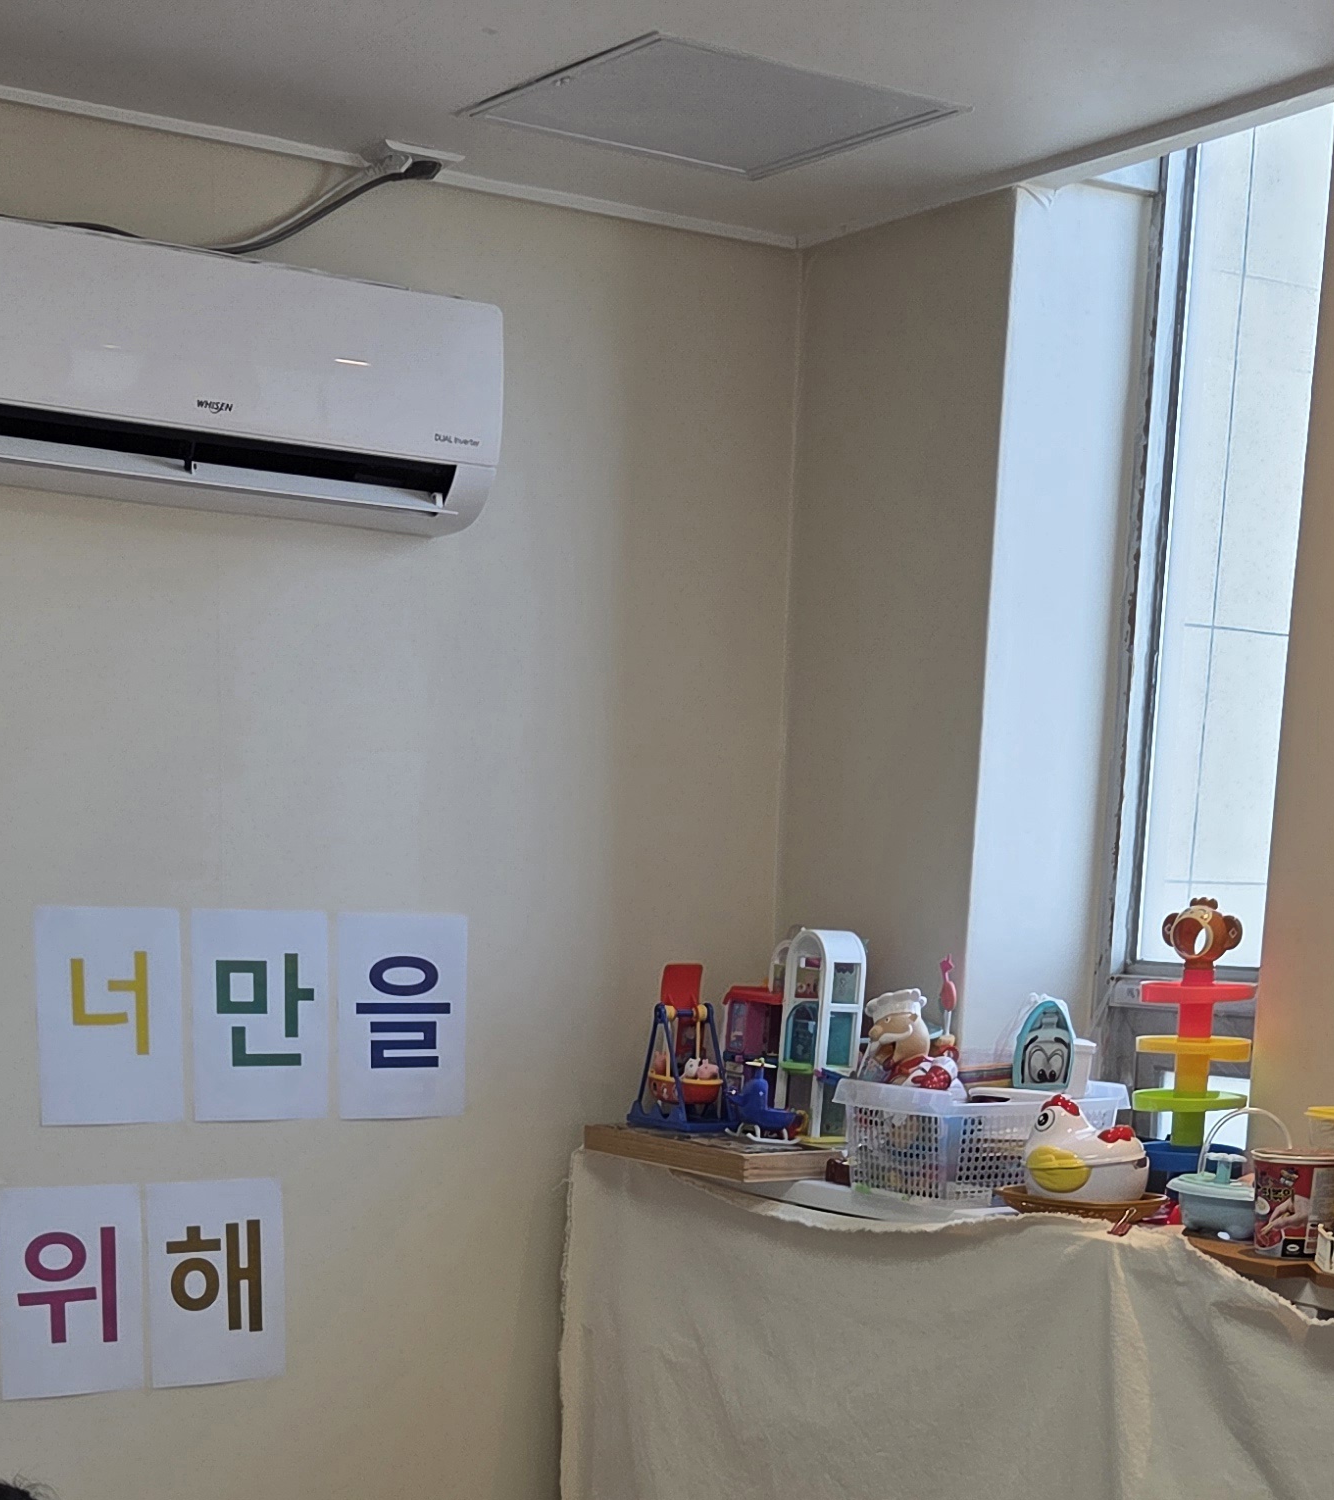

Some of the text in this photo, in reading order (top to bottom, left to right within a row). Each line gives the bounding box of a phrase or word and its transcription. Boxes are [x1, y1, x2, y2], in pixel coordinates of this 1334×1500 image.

[196, 399, 234, 414] WHISEN
[434, 432, 453, 444] DUAL
[70, 950, 452, 1069] 너만을
[17, 1218, 264, 1344] 위해
